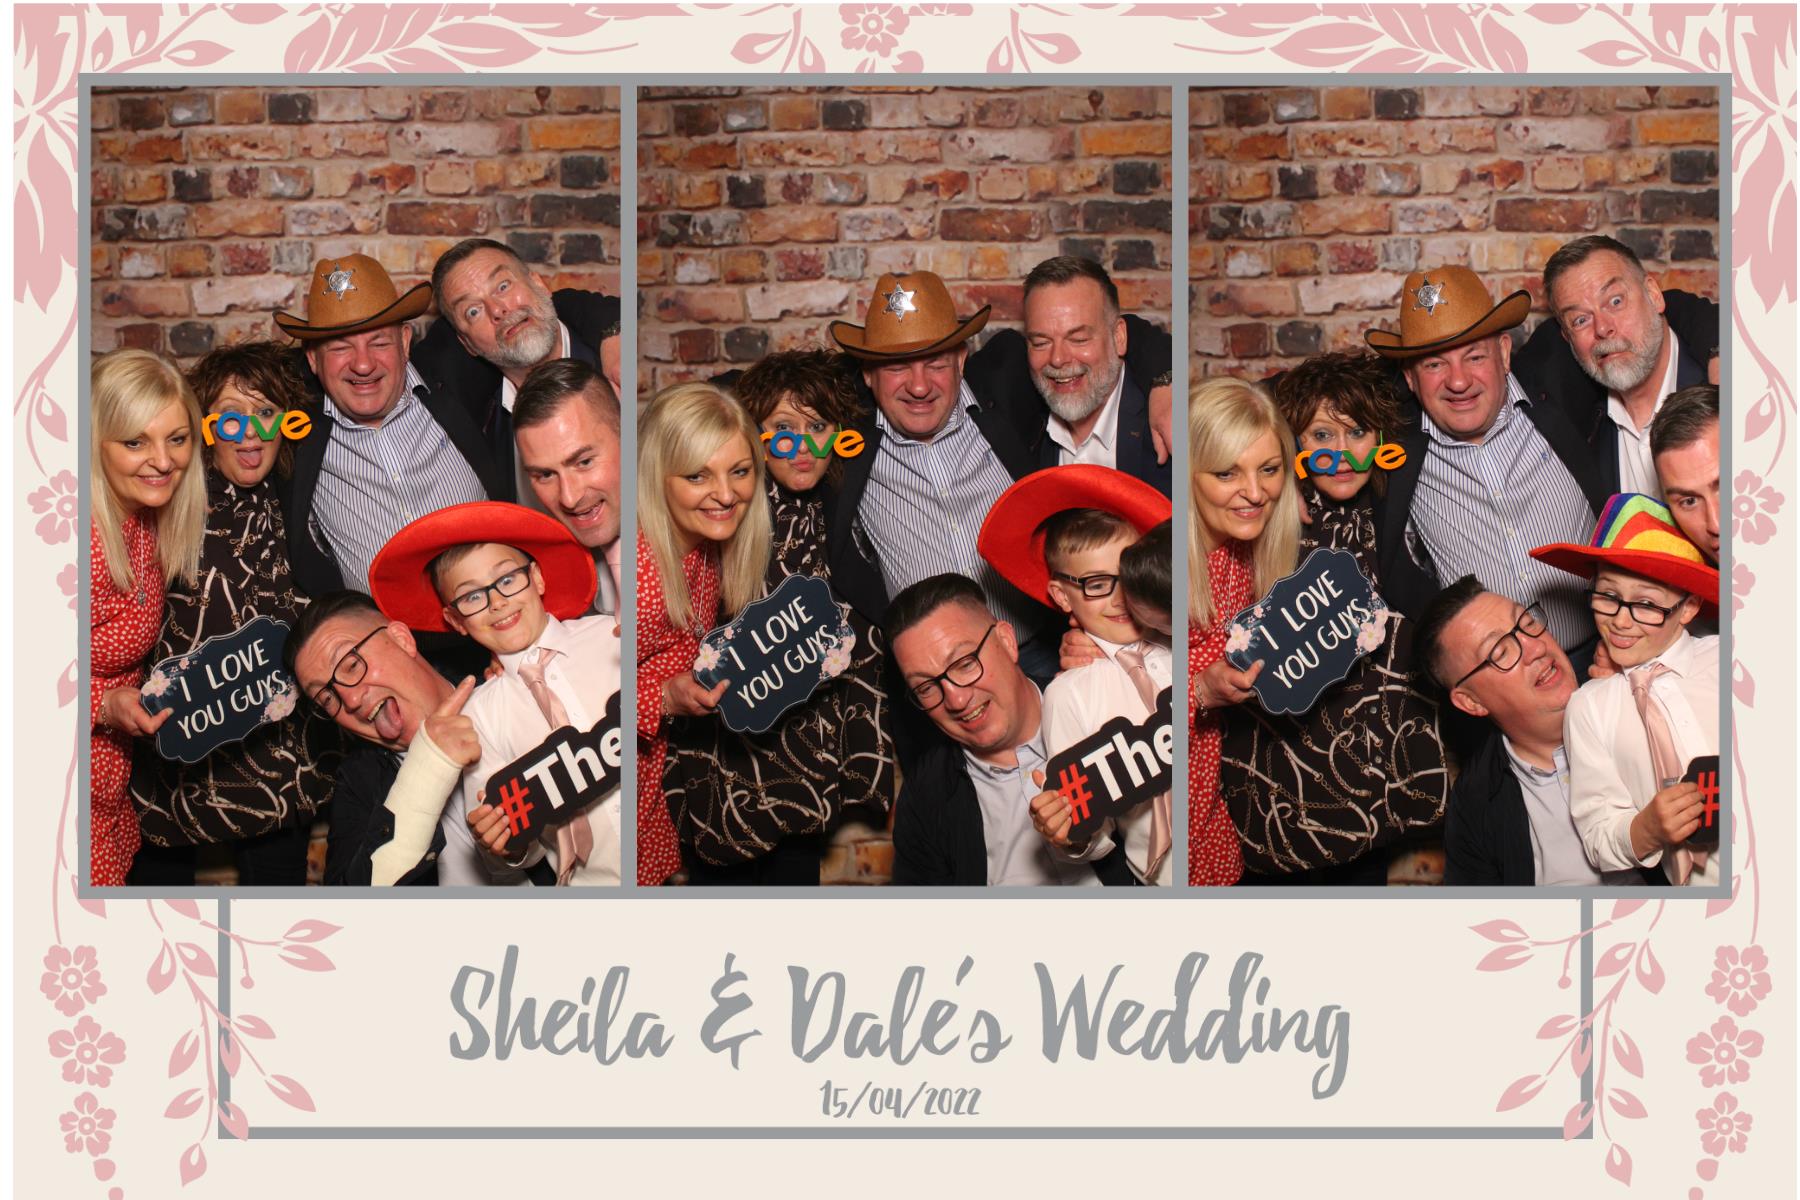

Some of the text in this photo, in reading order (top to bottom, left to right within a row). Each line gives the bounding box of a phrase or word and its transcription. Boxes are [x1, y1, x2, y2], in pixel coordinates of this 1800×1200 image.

[201, 410, 312, 446] rave
[1295, 443, 1407, 479] rave
[728, 595, 814, 671] I LOVE
[1259, 569, 1344, 650] I LOVE
[1272, 598, 1371, 689] YOU GUYS
[180, 638, 270, 702] I LOVE
[737, 624, 838, 709] YOU GUYS
[177, 669, 287, 739] YOU GUYS
